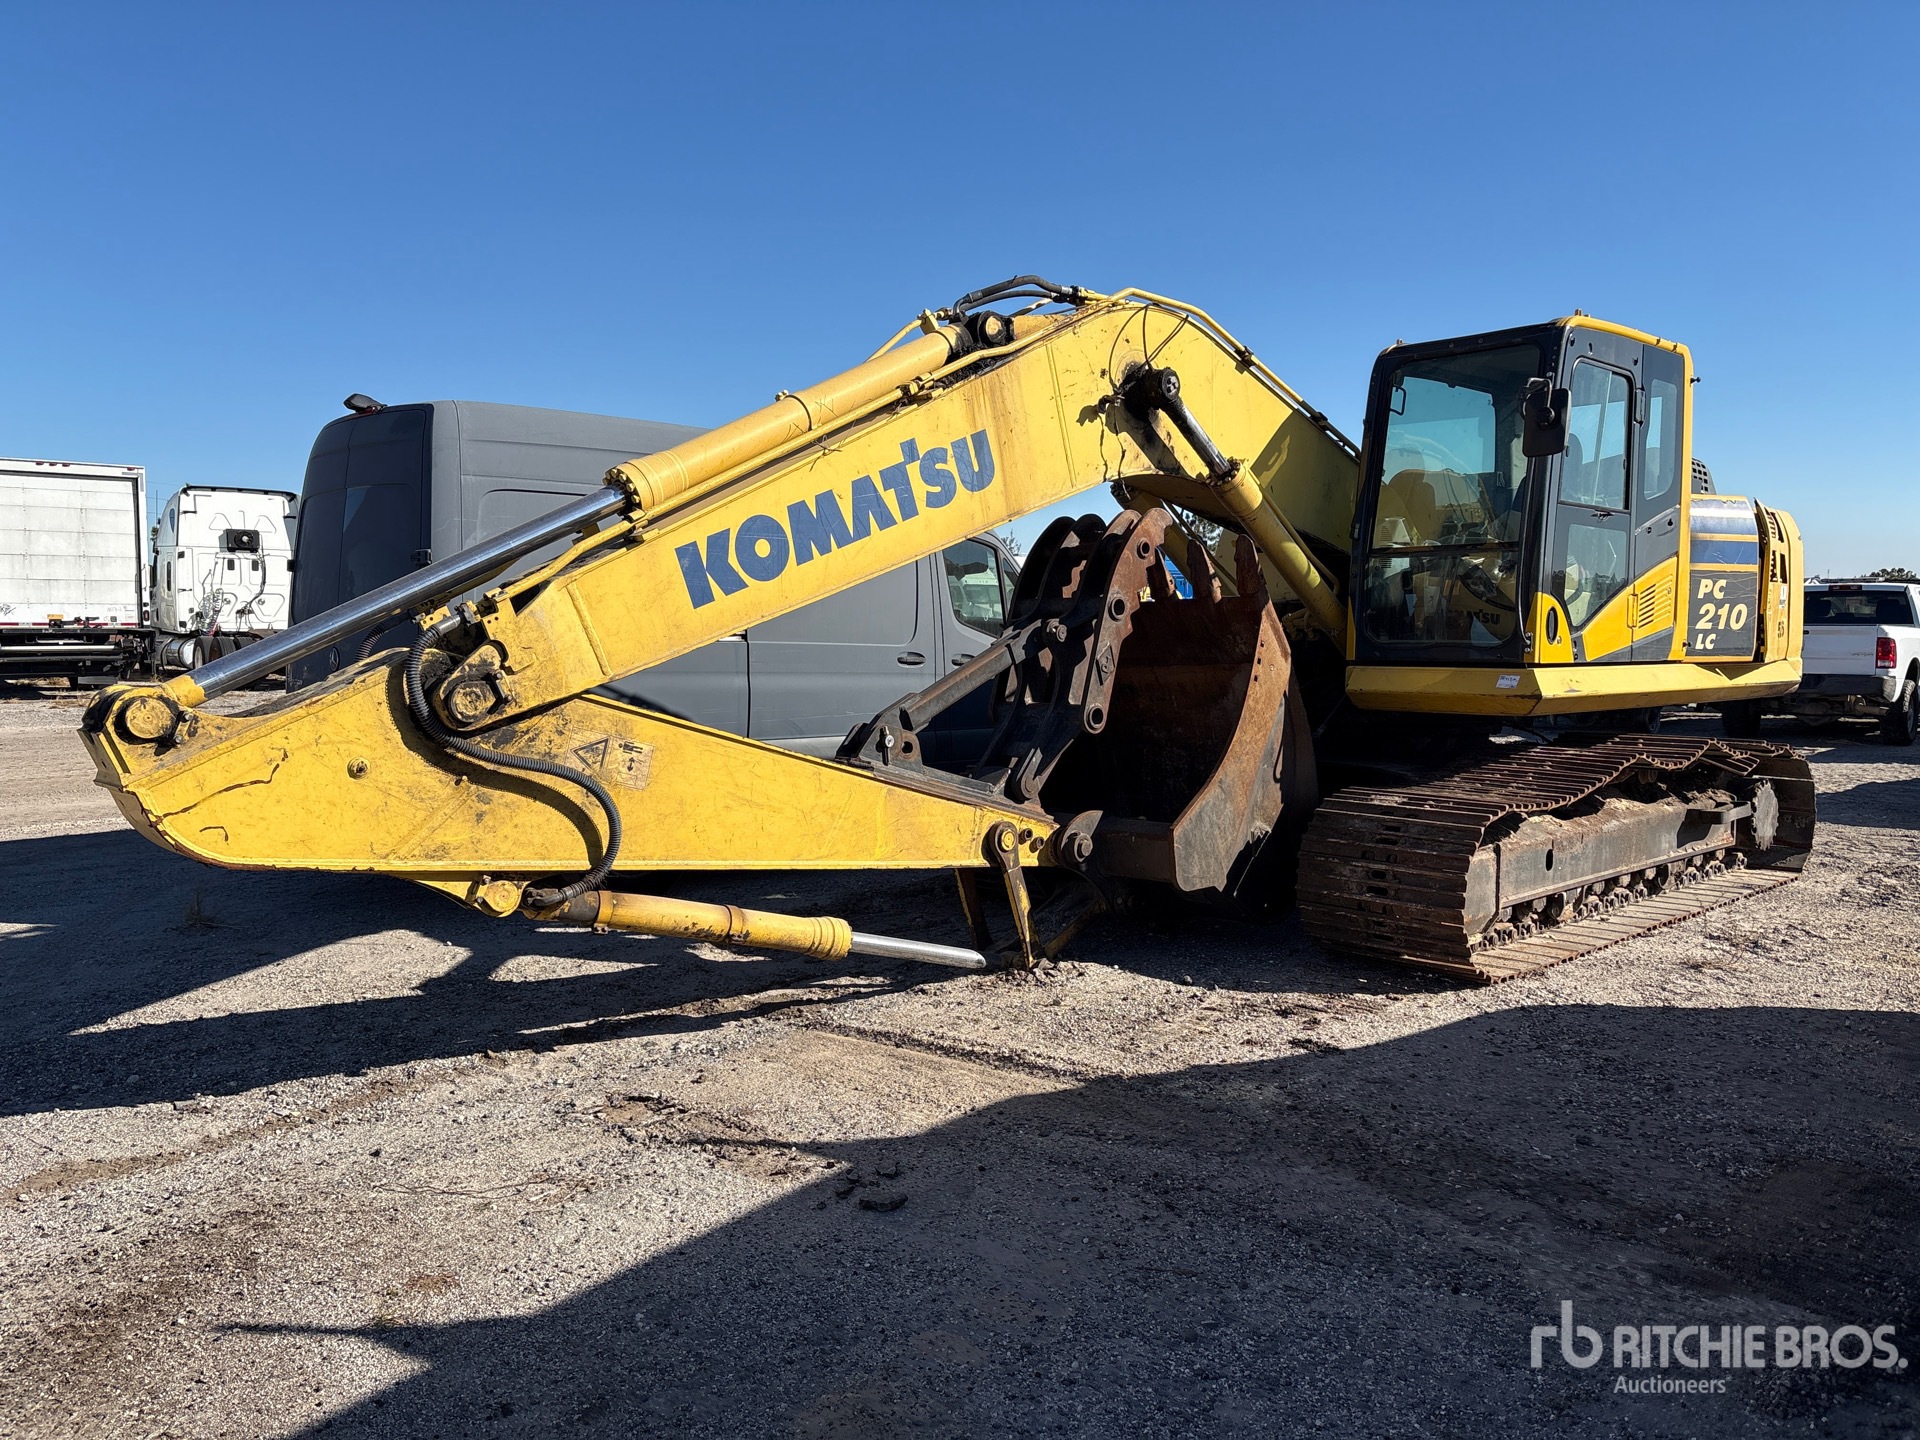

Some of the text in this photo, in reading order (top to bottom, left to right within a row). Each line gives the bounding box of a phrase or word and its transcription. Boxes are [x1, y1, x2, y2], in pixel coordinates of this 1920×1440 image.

[674, 429, 996, 610] KOMATSU
[1697, 578, 1727, 600] PC
[1695, 602, 1748, 631] 210
[1695, 633, 1717, 650] LC
